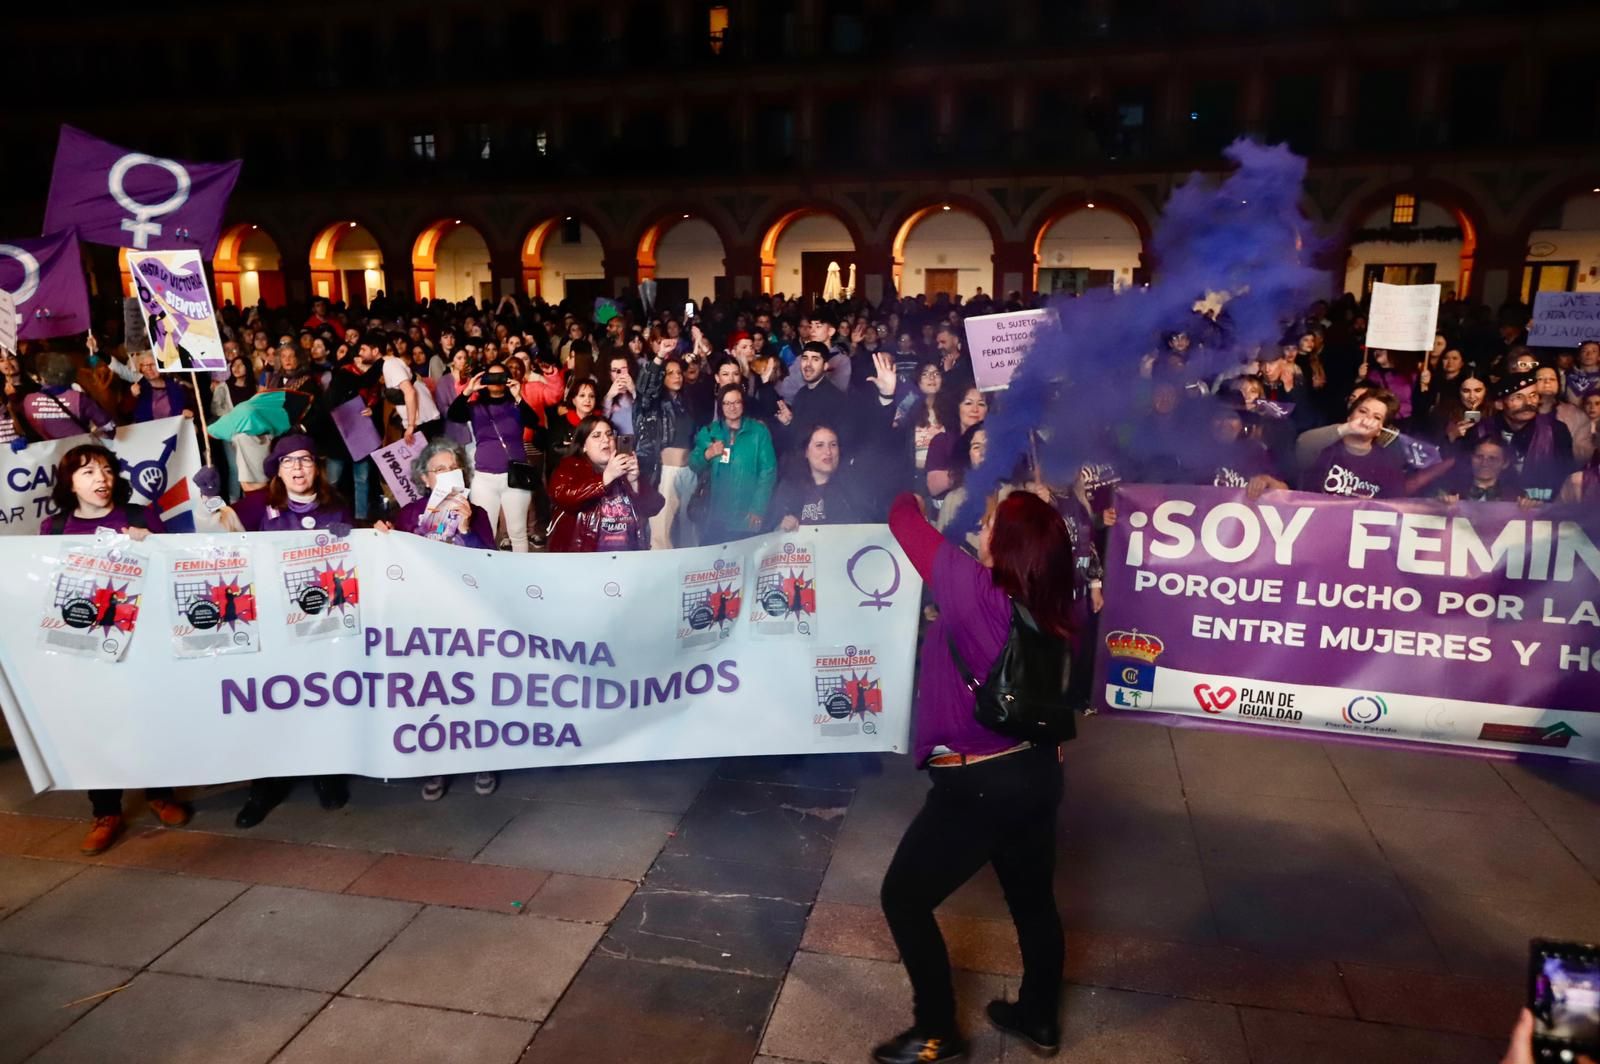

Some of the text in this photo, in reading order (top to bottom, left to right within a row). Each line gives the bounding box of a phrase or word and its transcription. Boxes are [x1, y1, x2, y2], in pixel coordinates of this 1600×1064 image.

[139, 263, 159, 278] HASTA
[169, 272, 204, 292] VICTORIA
[165, 290, 210, 319] SIEMPRE
[996, 318, 1038, 330] EL SUJETO
[992, 332, 1028, 343] POLÍTICO
[982, 344, 1028, 357] FEMINISMO
[990, 360, 1005, 369] LAS
[1324, 464, 1343, 492] 8
[1125, 500, 1315, 567] ¡SOY
[282, 542, 350, 560] FEMINISMO
[761, 553, 811, 567] FEMINISMO
[66, 554, 142, 576] FEMINISMO
[174, 558, 247, 571] FEMINISMO
[684, 566, 740, 583] FEMINISMO
[1134, 570, 1600, 627] PORQUE LUCHO POR LA
[364, 626, 616, 668] PLATAFORMA
[1191, 614, 1306, 648] ENTRE
[1319, 624, 1492, 663] MUJERES
[1512, 640, 1542, 666] Y
[816, 656, 876, 666] FEMINISMO
[221, 660, 740, 714] NOSOTRAS DECIDIMOS
[1240, 688, 1296, 708] PLAN DE
[1238, 703, 1302, 720] IGUALDAD
[392, 714, 582, 755] CÓRDOBA
